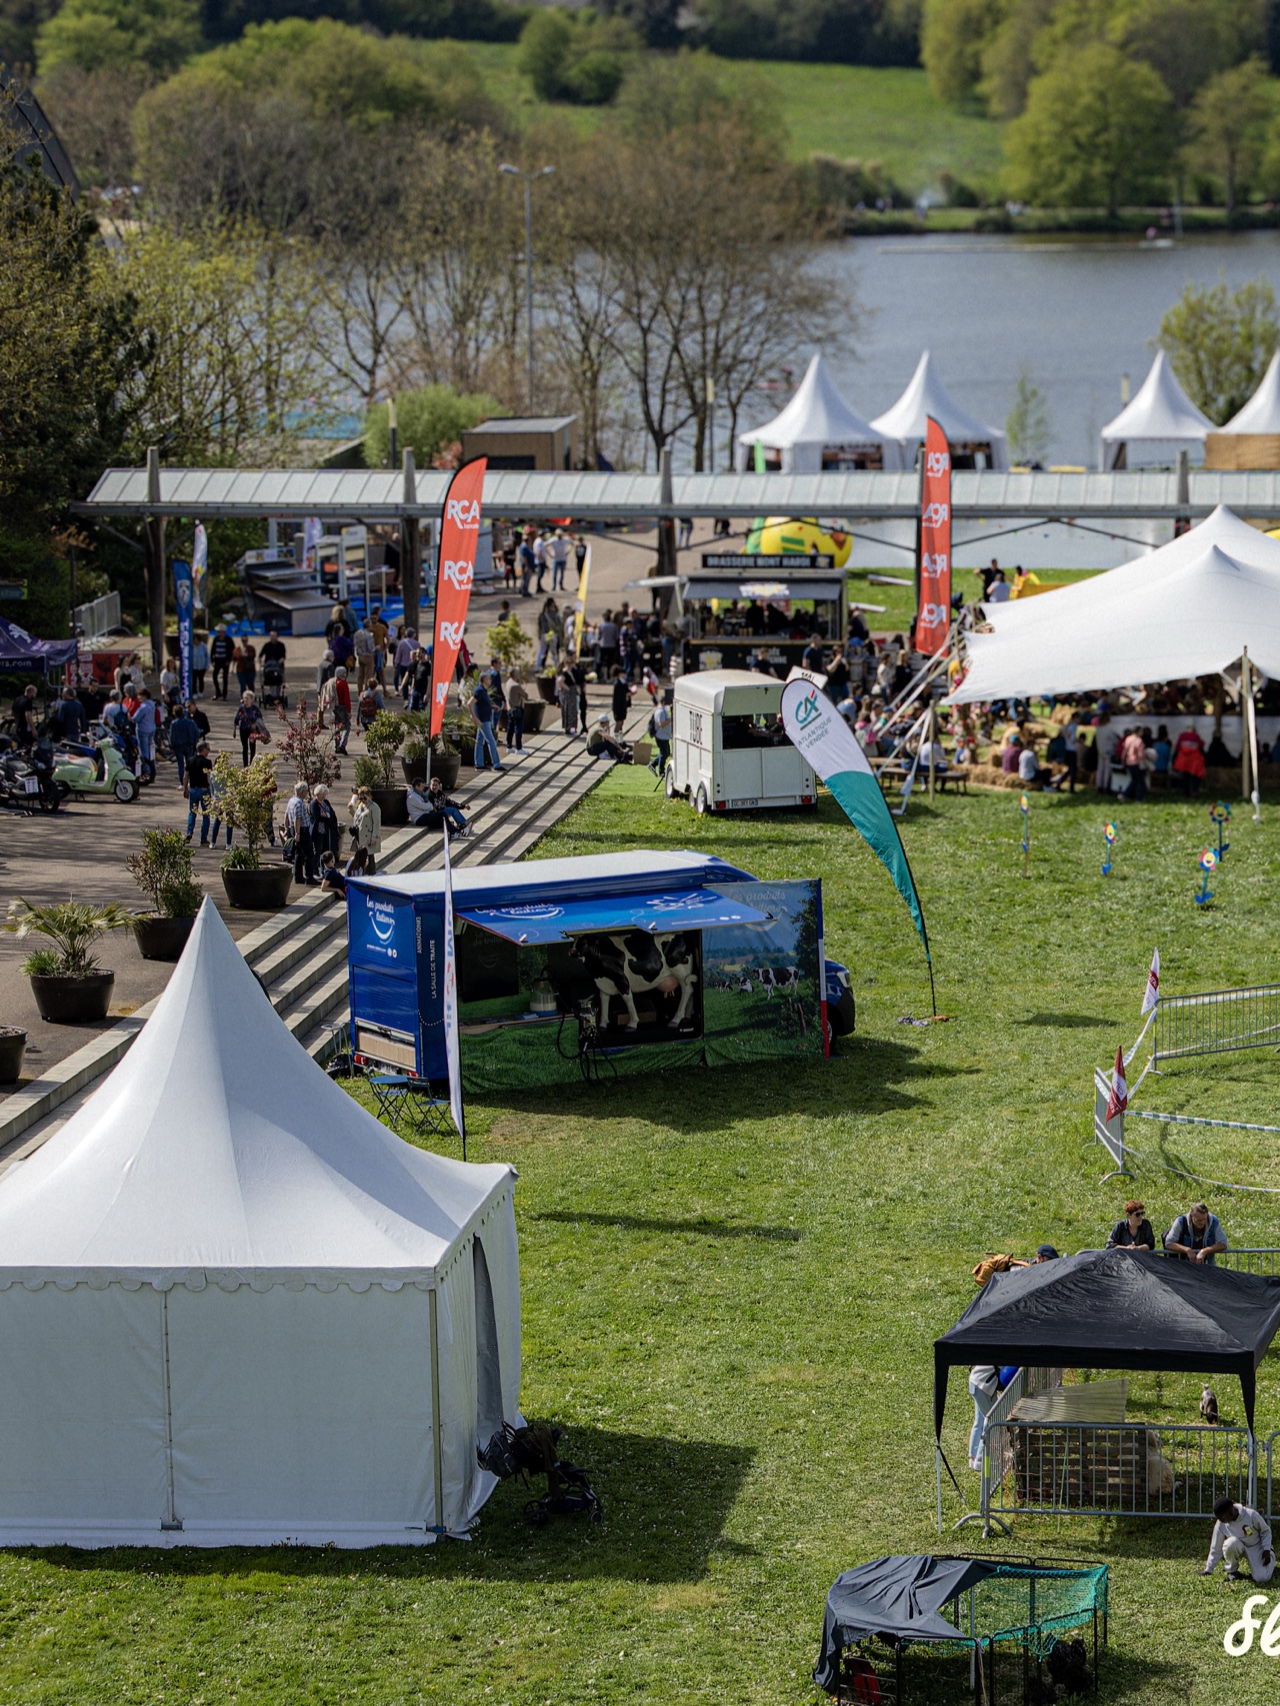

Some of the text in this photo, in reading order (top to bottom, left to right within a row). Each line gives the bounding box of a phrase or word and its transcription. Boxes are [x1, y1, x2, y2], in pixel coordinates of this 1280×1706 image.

[447, 499, 480, 529] RCA
[443, 560, 474, 589] RCA
[798, 715, 832, 746] ATLANTIQUE
[805, 727, 829, 749] VENDÉE
